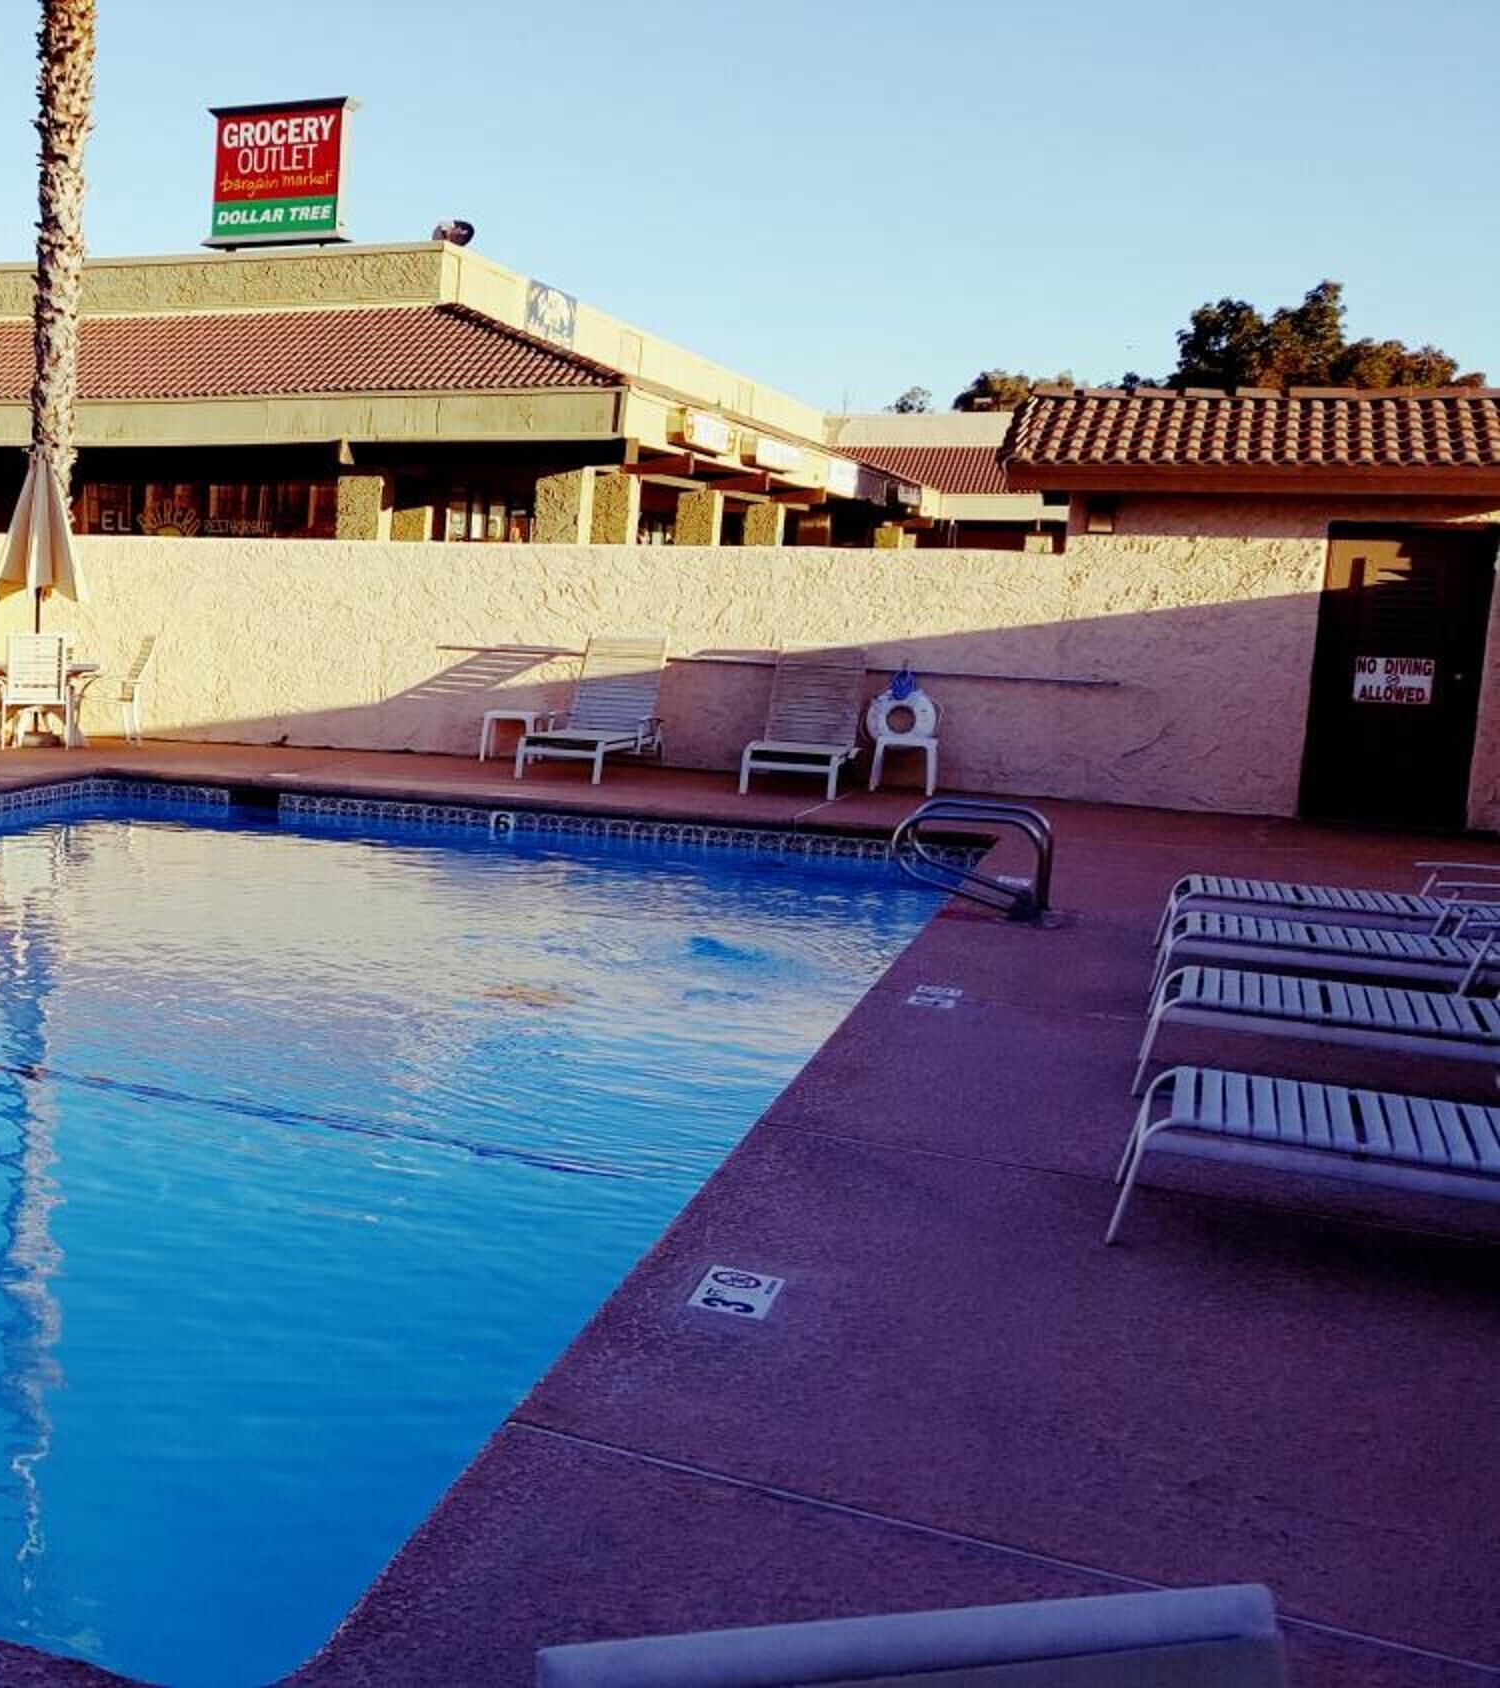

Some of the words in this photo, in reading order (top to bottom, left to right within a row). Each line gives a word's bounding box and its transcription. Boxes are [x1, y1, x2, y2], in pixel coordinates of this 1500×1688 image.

[222, 115, 335, 148] GROCERY
[237, 144, 318, 174] OUTLET
[220, 171, 279, 198] bargain
[282, 169, 334, 187] market
[217, 208, 285, 225] DOLLAR
[289, 205, 333, 221] TREE
[101, 510, 132, 532] EL
[1357, 659, 1377, 674] NO
[1385, 660, 1433, 677] DIVING
[1359, 685, 1425, 703] ALLOWED
[495, 813, 510, 833] 6
[701, 1297, 755, 1313] 3
